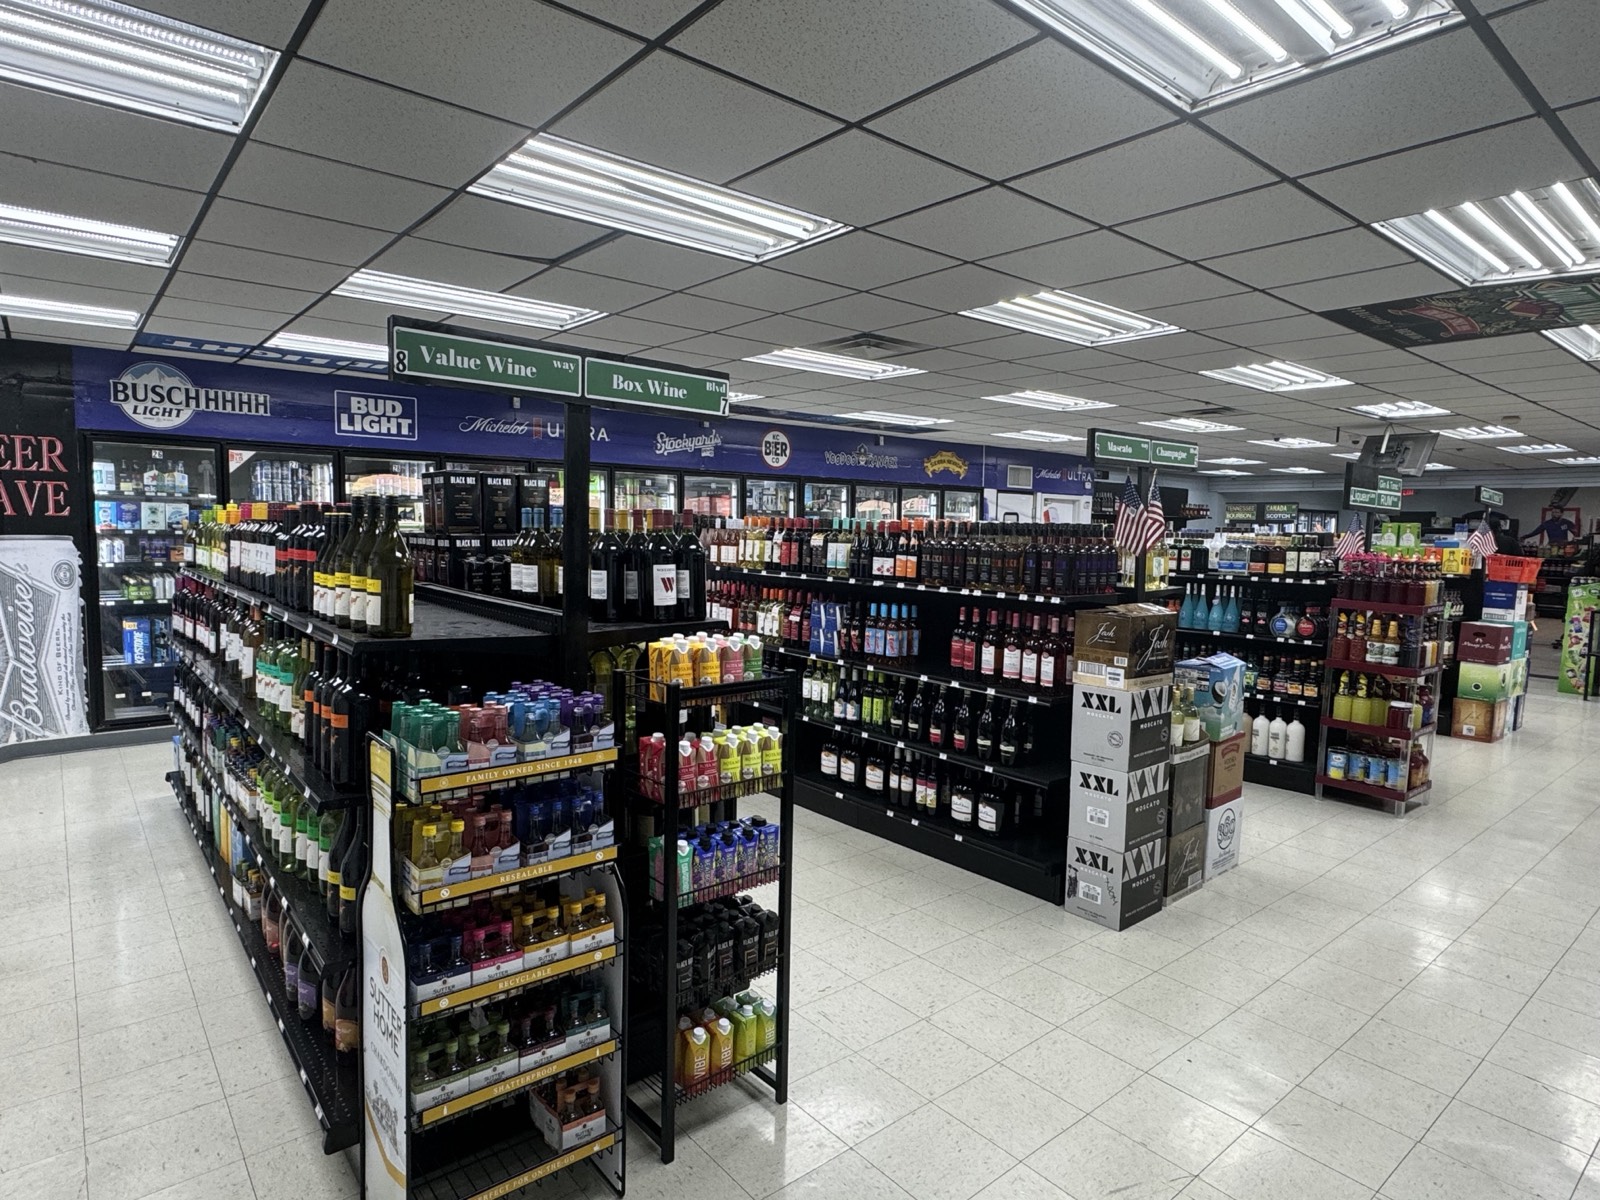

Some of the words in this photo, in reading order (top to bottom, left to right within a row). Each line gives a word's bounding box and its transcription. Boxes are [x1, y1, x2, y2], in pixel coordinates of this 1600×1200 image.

[396, 351, 407, 373] 8
[419, 345, 481, 371] Value
[485, 355, 537, 378] Wine
[552, 359, 576, 373] way
[612, 374, 644, 393] Box
[647, 379, 687, 399] Wine
[706, 382, 726, 393] Blvd
[132, 405, 184, 418] LIGHT
[350, 396, 403, 416] BUD
[721, 398, 728, 415] 7
[340, 413, 412, 435] LIGHT
[458, 415, 530, 435] Michelob
[547, 422, 610, 442] URA
[655, 429, 722, 455] Stockyards
[824, 451, 858, 466] VOODOO
[450, 476, 465, 485] BLACK
[466, 477, 476, 485] BOX
[487, 477, 502, 485] BLACK
[503, 478, 512, 486] BOX
[524, 479, 537, 487] BLACK
[537, 479, 546, 488] BOX
[1068, 470, 1092, 482] ULTRA
[456, 539, 470, 547] BLACK
[471, 540, 480, 548] BOX
[1086, 622, 1117, 645] Josh
[1137, 624, 1170, 670] Josh
[1081, 691, 1121, 714] XXL
[1131, 686, 1172, 721] XXL
[1087, 711, 1114, 720] MOSCATO
[1140, 719, 1163, 730] MOSCATO
[466, 771, 499, 783] FAMILY
[502, 765, 534, 777] OWNED
[536, 761, 560, 771] SINCE
[564, 757, 582, 766] 1948
[1079, 771, 1119, 797] XXL
[1127, 763, 1170, 804] XXL
[1084, 791, 1112, 802] MOSCATO
[1135, 799, 1160, 813] MOSCATO
[1075, 846, 1114, 874] XXL
[1121, 838, 1166, 883] XXL
[500, 864, 553, 883] RESEALABLE
[1080, 866, 1107, 879] MOSCATO
[1132, 873, 1156, 888] MOSCATO
[487, 969, 509, 979] SUTTER
[498, 967, 552, 990] RECYCLABLE
[433, 984, 456, 994] SUTTER
[370, 976, 403, 1038] SUTTER
[373, 1004, 399, 1058] HOME
[694, 1054, 706, 1079] VIBE
[722, 1043, 732, 1068] VIBE
[493, 1064, 558, 1094] SHATTERPROOF
[513, 1176, 529, 1189] FOR
[532, 1154, 575, 1179] ON-THE-GO
